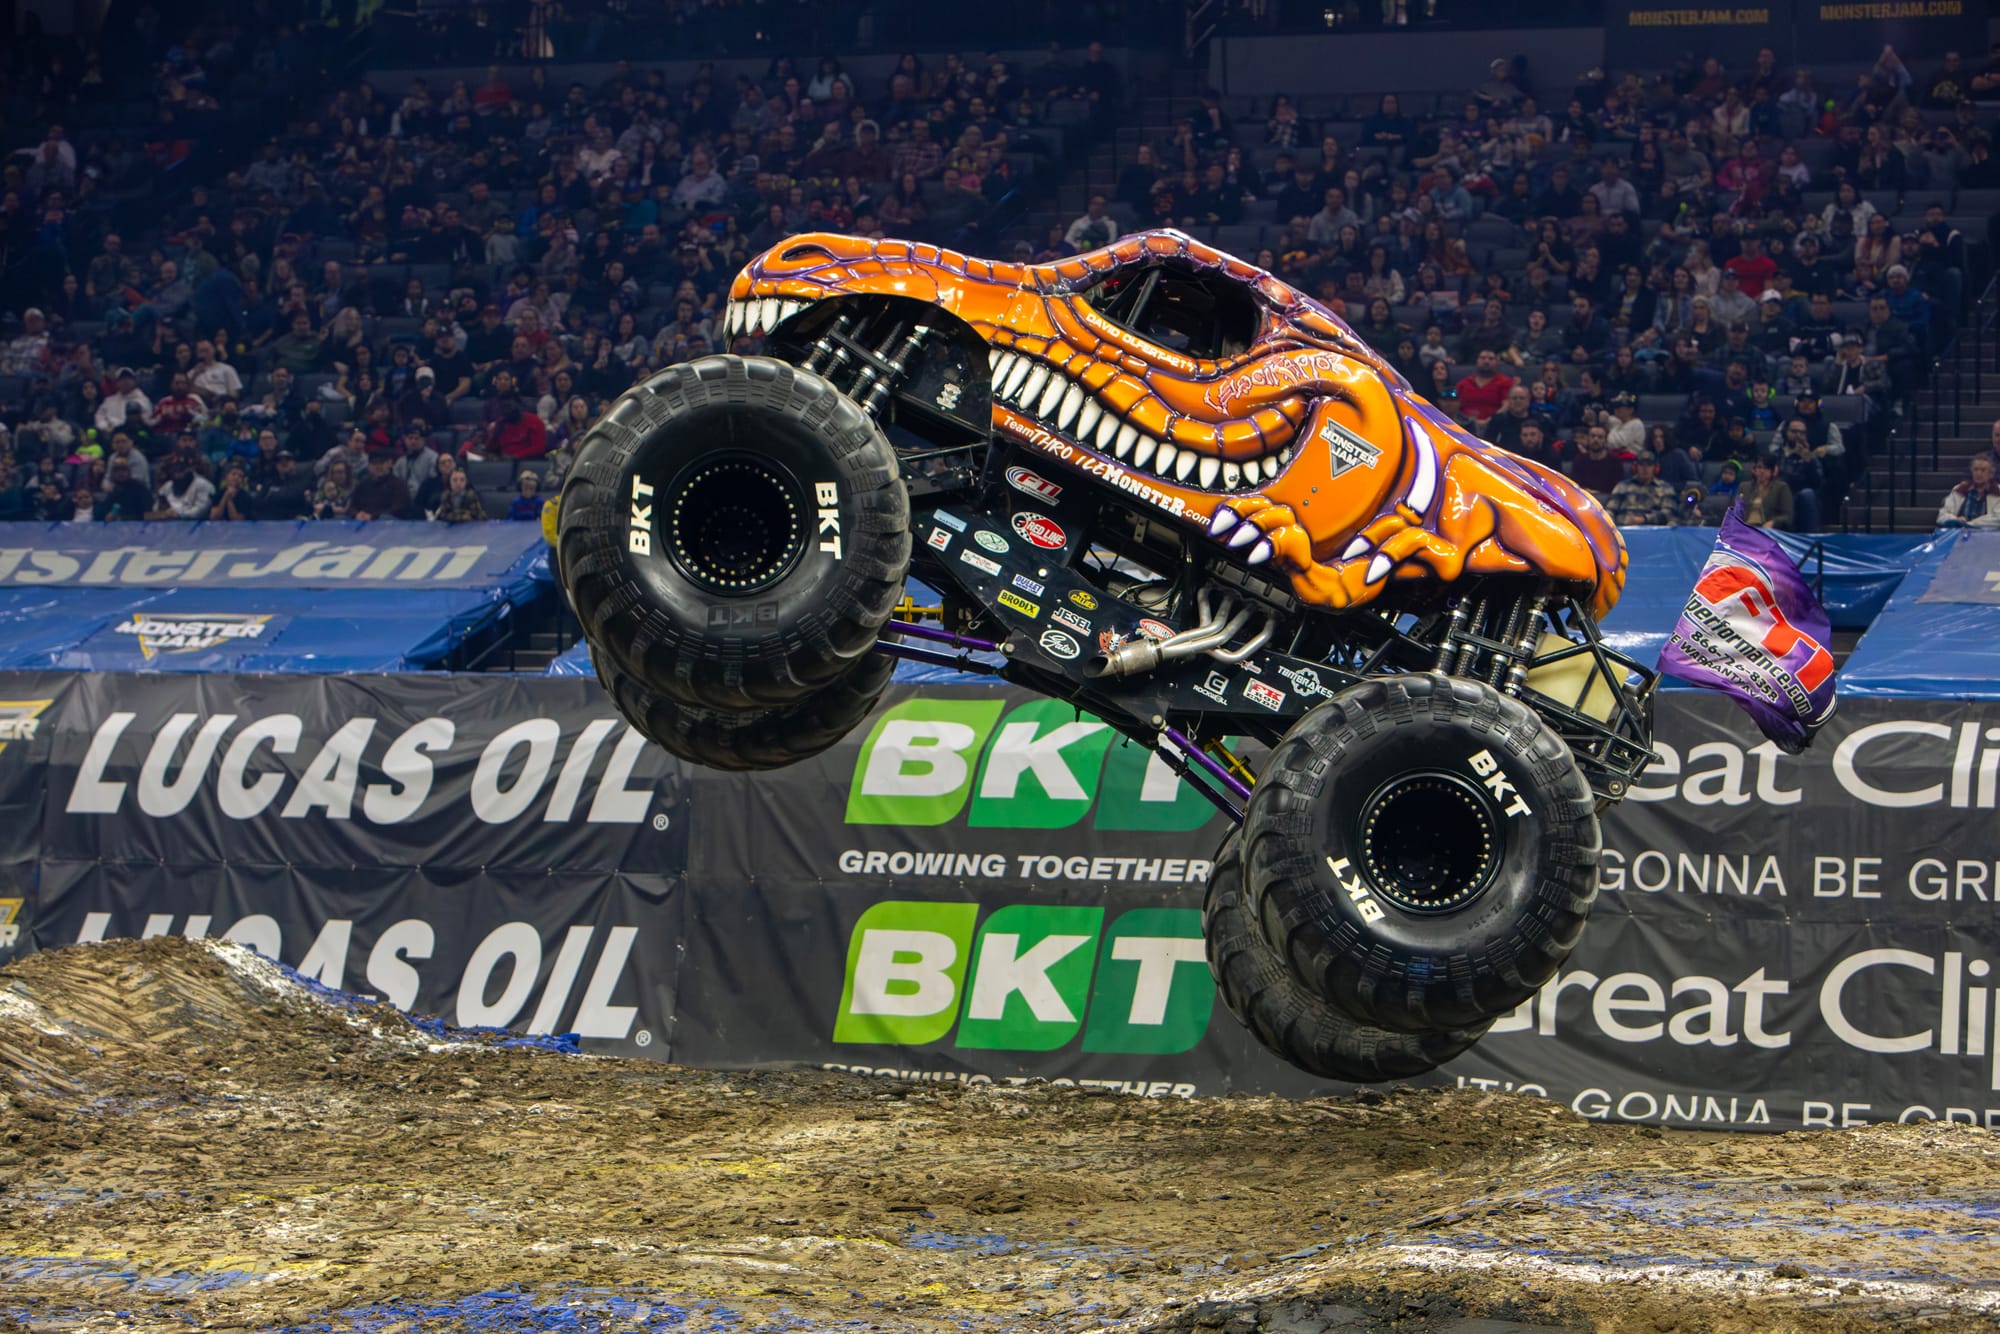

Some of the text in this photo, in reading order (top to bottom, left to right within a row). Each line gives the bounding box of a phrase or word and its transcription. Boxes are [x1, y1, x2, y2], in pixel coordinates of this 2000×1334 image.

[1629, 8, 1769, 27] MONSTERJAM.COM
[1820, 0, 1962, 20] MONSTERJAM.COM
[1086, 313, 1120, 338] DAVID
[1320, 426, 1378, 470] MONSTER
[1331, 447, 1359, 467] JAM
[1018, 472, 1062, 498] FTI
[629, 473, 656, 557] BKT
[814, 481, 842, 561] BKT
[1027, 521, 1045, 536] RED
[1044, 527, 1065, 546] LINE
[1000, 592, 1037, 614] BRODIX
[114, 621, 266, 638] MONSTER
[1054, 608, 1092, 634] JESEL
[144, 635, 214, 648] JAM
[1041, 634, 1076, 657] Gates
[66, 712, 456, 824] LUCAS
[1467, 748, 1532, 819] BKT
[839, 850, 1211, 882] GROWING TOGETHER
[1600, 849, 1788, 896] GONNA
[1813, 856, 1883, 899] BE
[1326, 855, 1386, 927] BKT
[849, 928, 1207, 1025] BKT
[1819, 948, 2000, 1091] Cli
